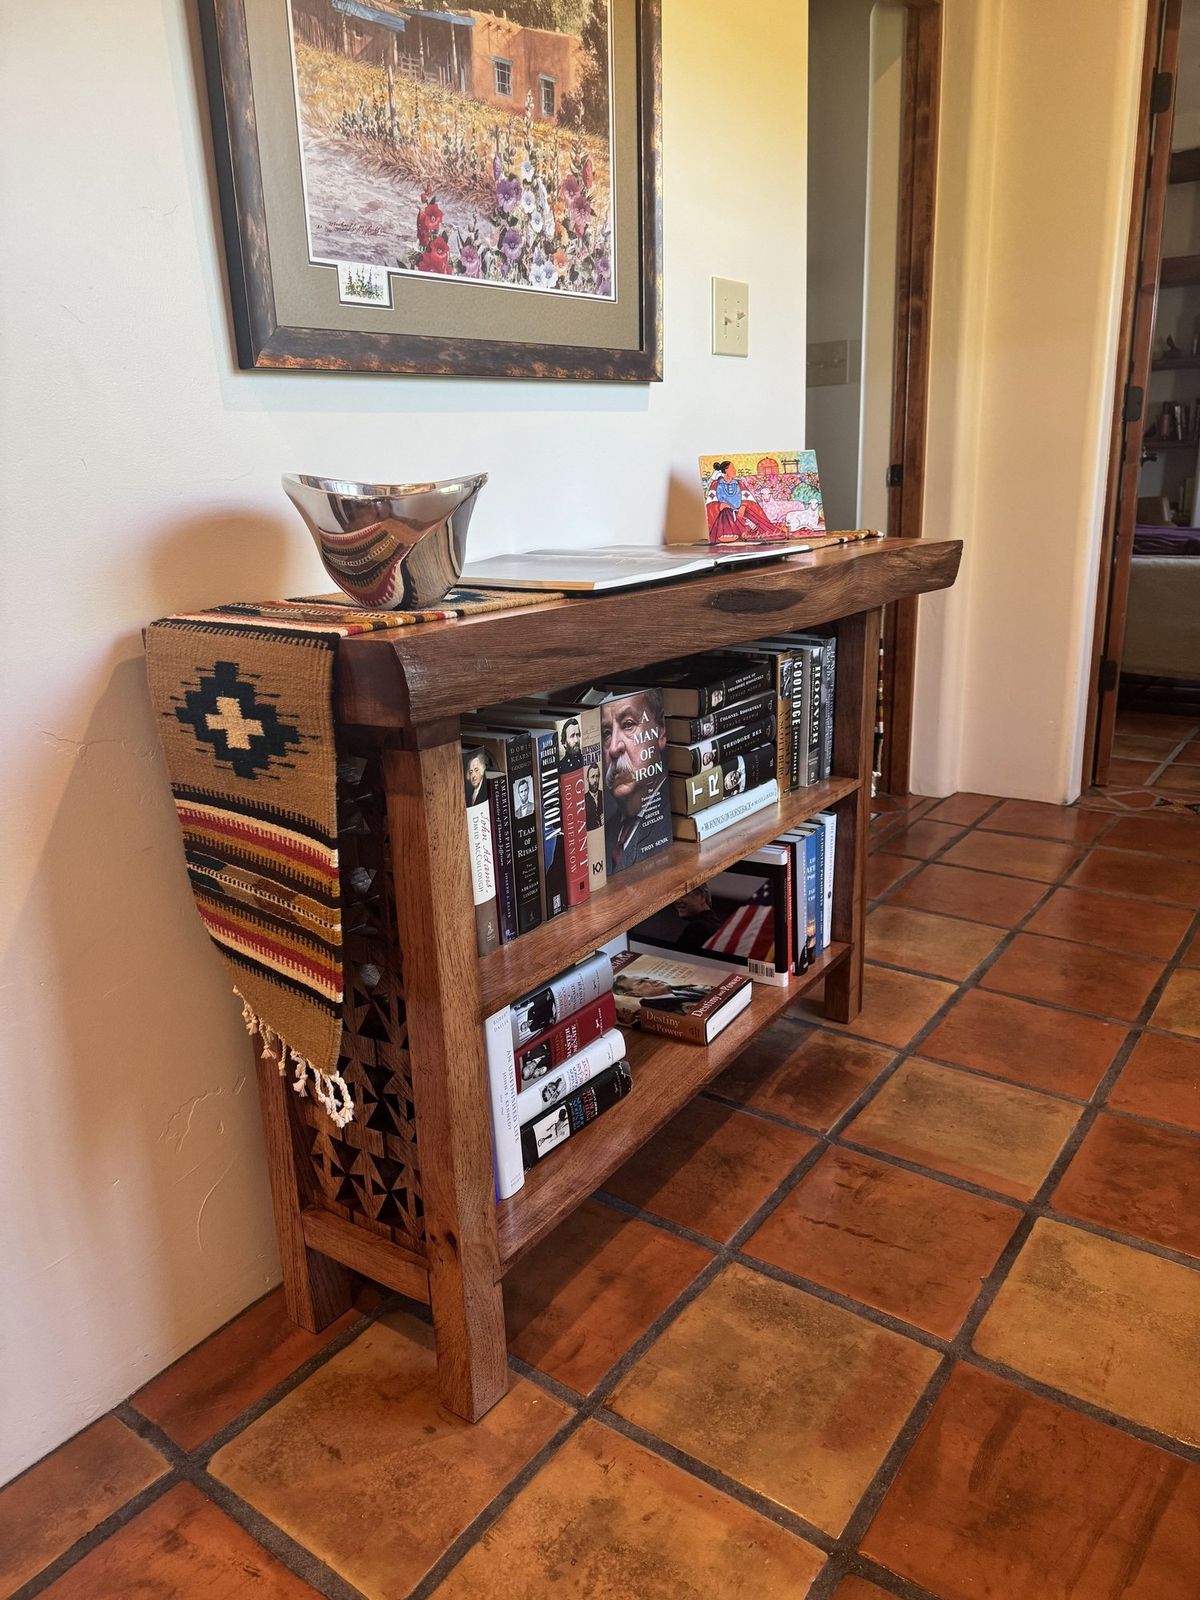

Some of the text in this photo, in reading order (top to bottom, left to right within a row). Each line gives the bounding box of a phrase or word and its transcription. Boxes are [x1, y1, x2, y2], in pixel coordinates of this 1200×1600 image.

[792, 661, 802, 726] COOLIDGE
[720, 704, 762, 722] COLONEL ROOSEVELT
[813, 666, 822, 744] HOOVER
[641, 711, 650, 724] A
[633, 726, 658, 746] MAN
[723, 729, 762, 750] THEODORE REX
[640, 746, 655, 761] OF
[634, 761, 663, 782] IRON
[692, 782, 703, 804] T
[708, 772, 720, 797] R
[542, 768, 564, 840] LINCOLN
[472, 816, 480, 840] DAVID
[480, 811, 490, 842] John
[500, 778, 512, 865] AMERICAN SPHINX
[518, 826, 536, 838] TEAM
[564, 784, 577, 874] RON CHERNOW
[575, 778, 588, 867] GRANT
[642, 815, 664, 828] CLEVELAND
[518, 845, 538, 858] RIVALS
[524, 838, 532, 846] OF
[640, 836, 669, 853] TROY SENIK
[691, 994, 722, 1018] Destiny
[724, 975, 743, 992] Power
[646, 1010, 680, 1028] Destiny
[656, 1024, 683, 1038] Power
[506, 1050, 512, 1058] AN
[506, 1060, 519, 1122] UNFINISHED
